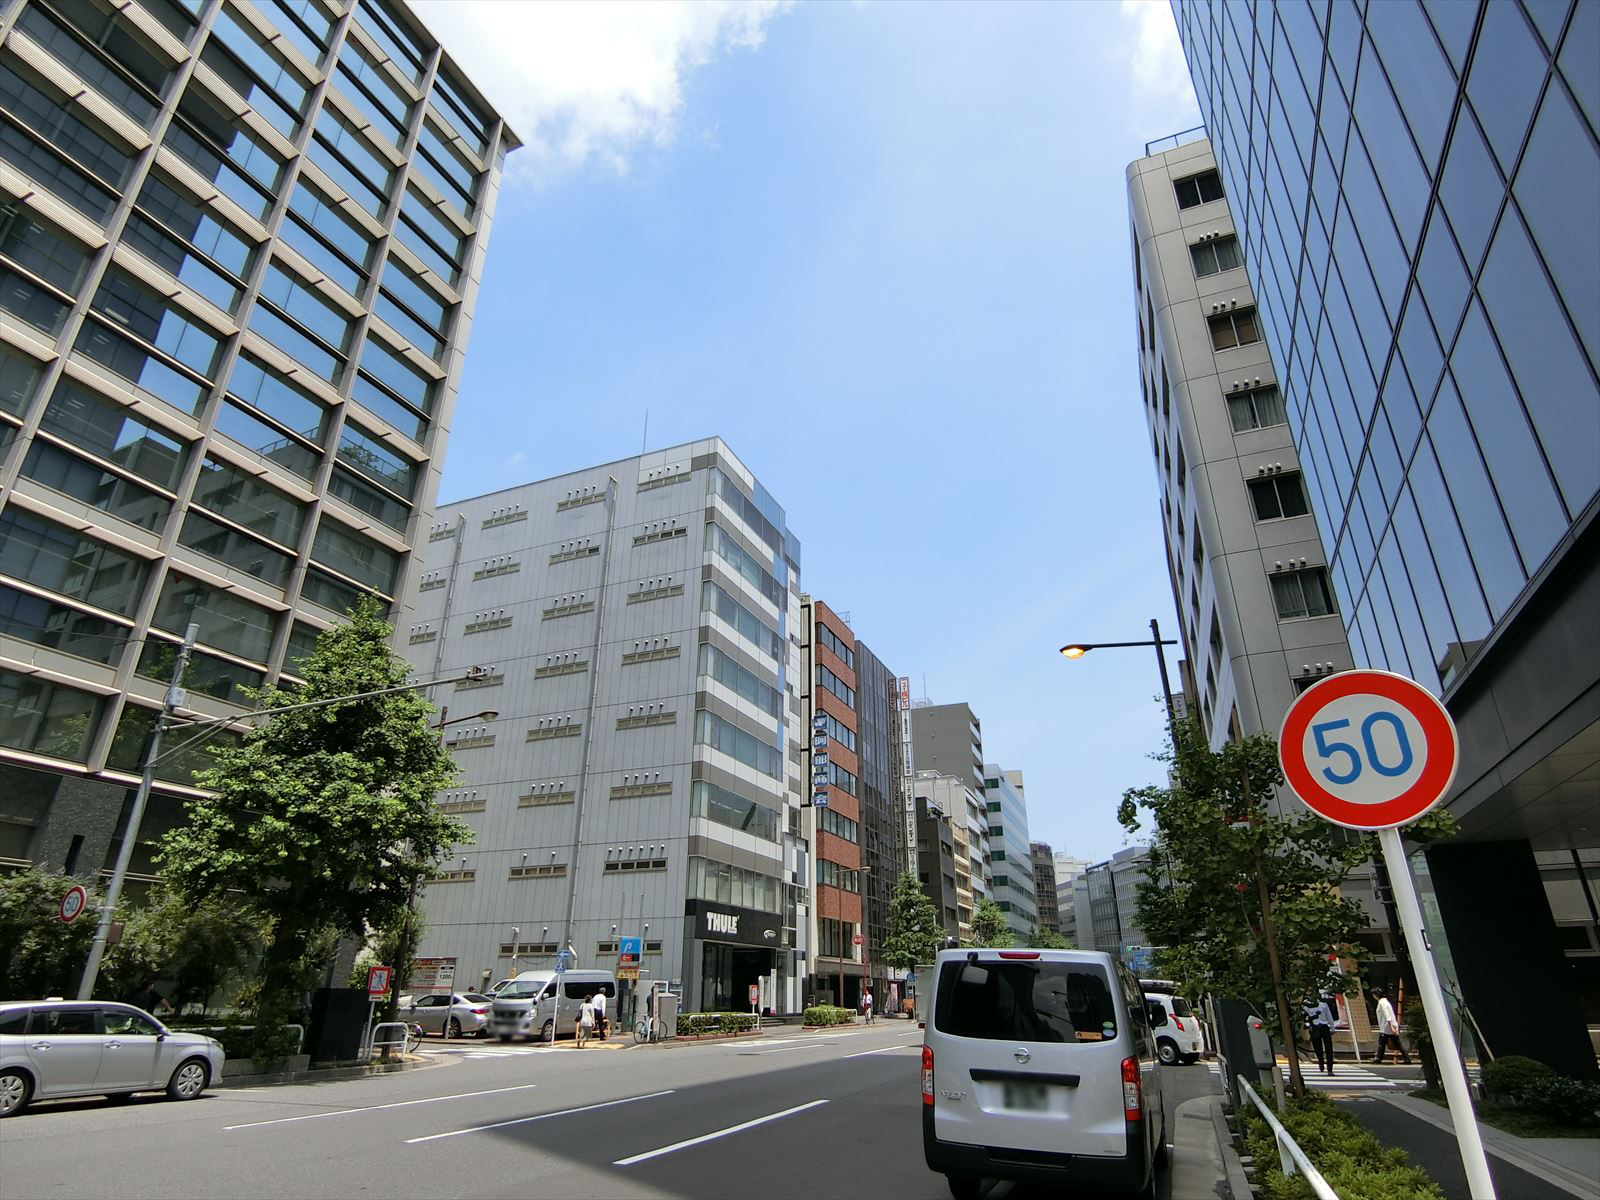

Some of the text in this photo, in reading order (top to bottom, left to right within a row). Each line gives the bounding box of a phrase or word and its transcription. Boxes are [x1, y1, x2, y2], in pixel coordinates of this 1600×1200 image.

[1312, 711, 1413, 785] 50
[64, 896, 80, 912] 50
[706, 911, 738, 934] THULE
